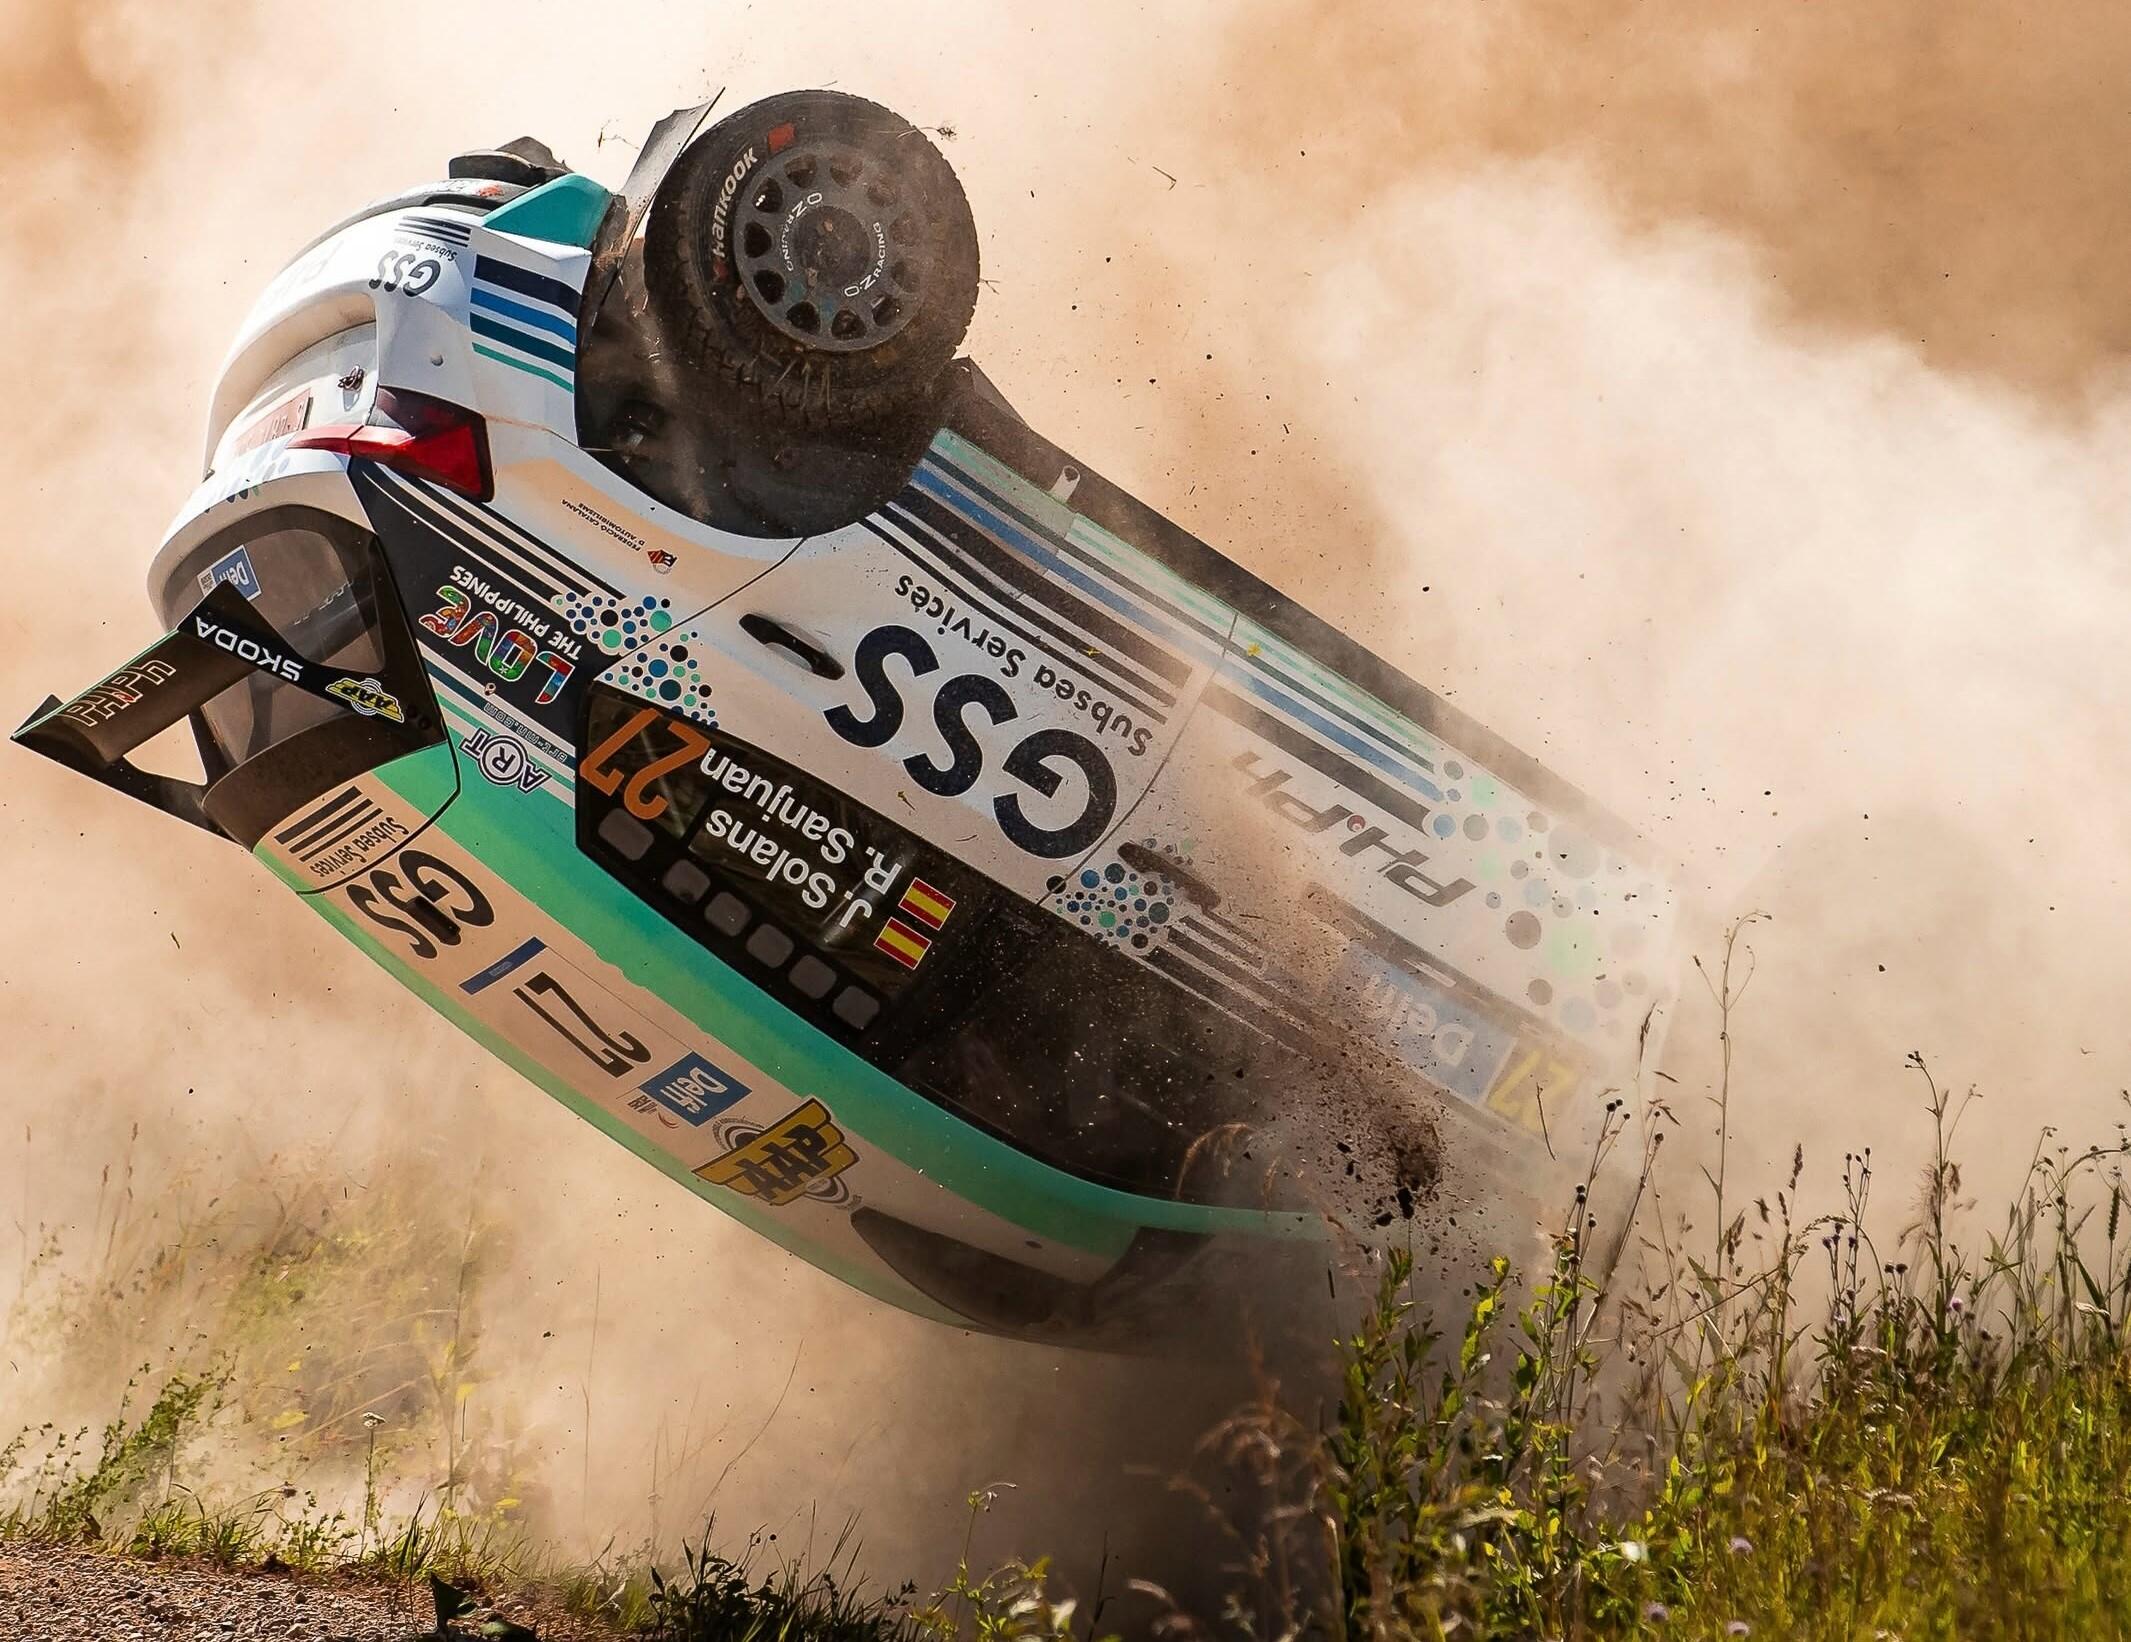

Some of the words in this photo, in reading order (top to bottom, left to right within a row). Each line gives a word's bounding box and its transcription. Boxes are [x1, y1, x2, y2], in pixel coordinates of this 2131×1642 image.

[366, 249, 442, 296] GSS
[423, 243, 457, 261] Subsea
[872, 219, 886, 277] RACING
[560, 497, 600, 526] CATALANA
[448, 562, 550, 638] PHILIPPINES
[891, 571, 1028, 679] Services
[416, 579, 576, 703] LOVE
[547, 627, 582, 660] THE
[821, 621, 1116, 859] GSS
[1029, 662, 1153, 757] Subsea
[457, 727, 551, 792] ART
[574, 704, 712, 821] 27
[351, 814, 409, 851] Subsea
[695, 746, 858, 864] Sanjuan
[308, 842, 366, 878] Services
[702, 804, 836, 908] Solans
[862, 844, 903, 894] R.
[342, 850, 494, 956] GSS
[838, 889, 873, 929] J.
[512, 969, 651, 1076] 27
[659, 1065, 728, 1114] Delfi
[734, 1122, 832, 1203] AAP
